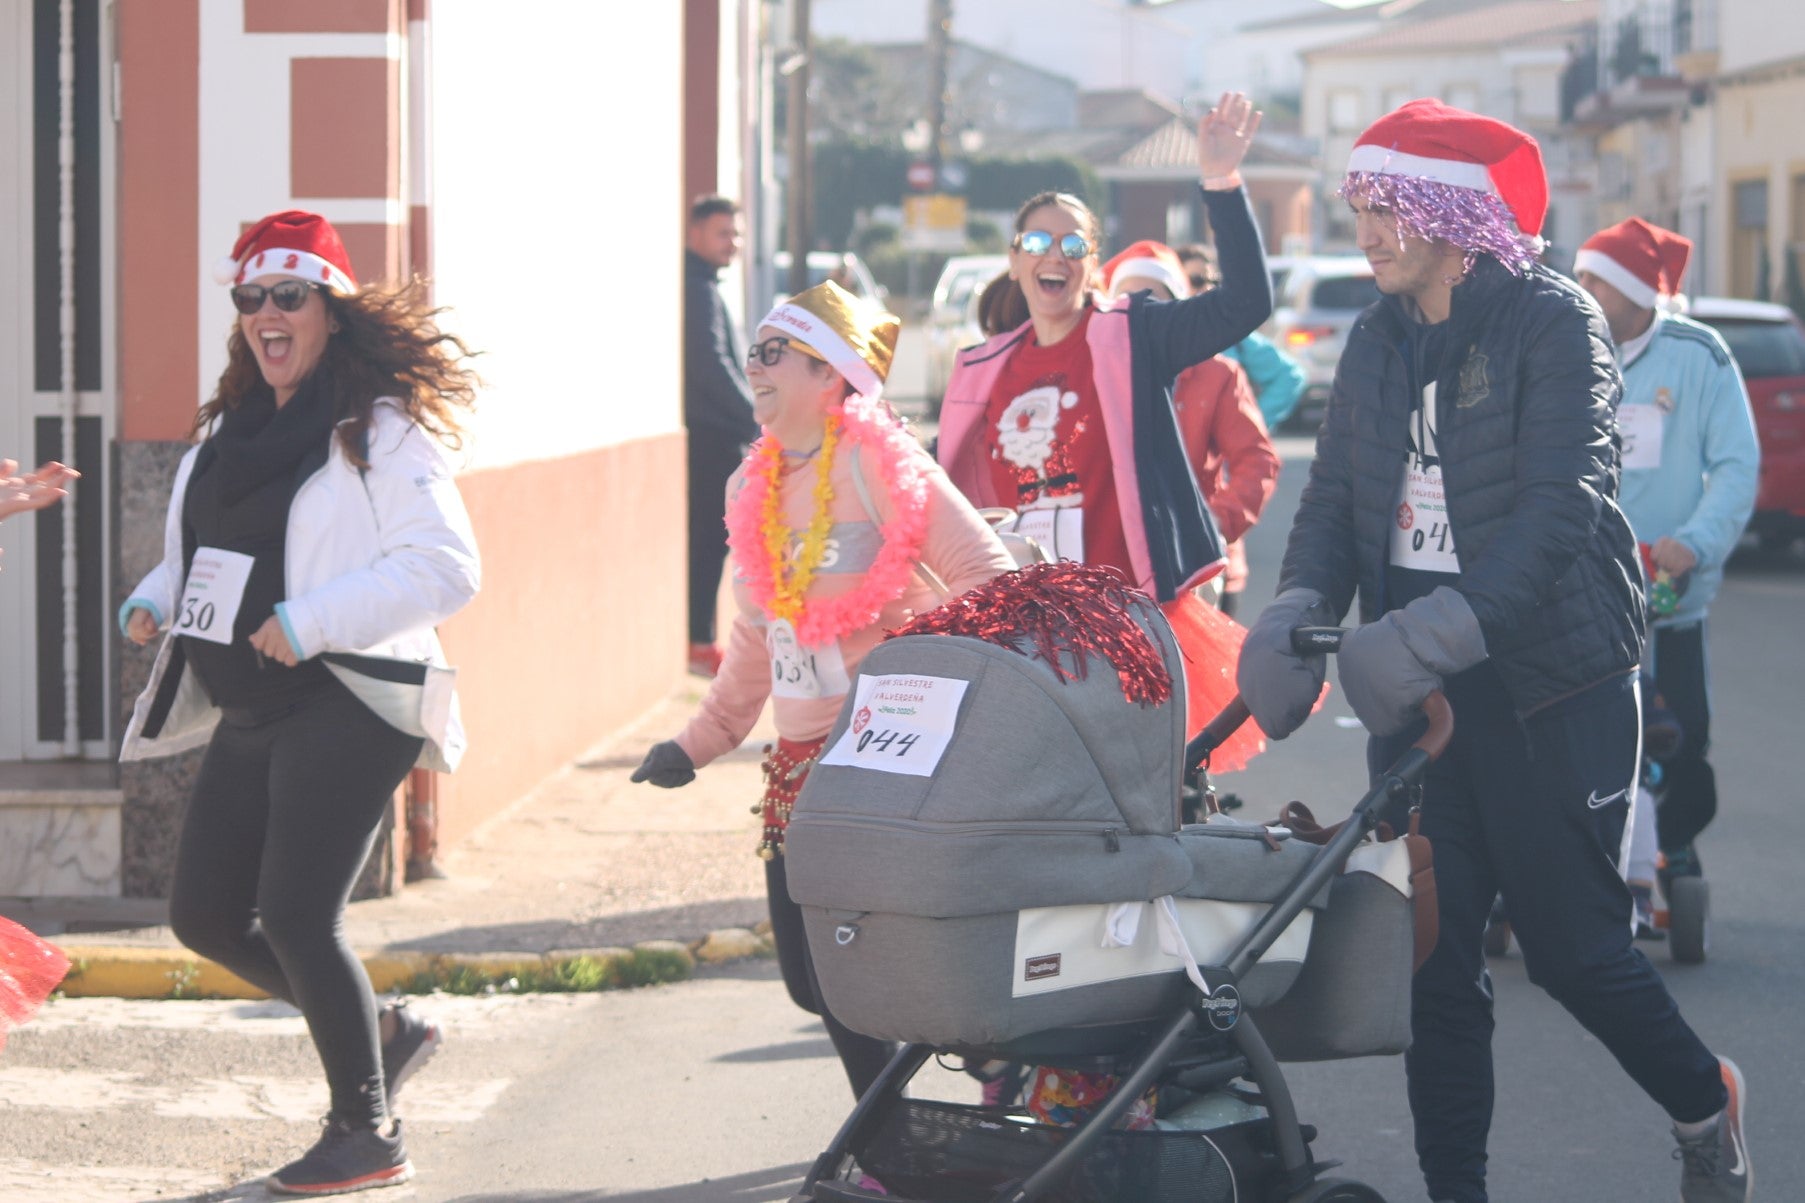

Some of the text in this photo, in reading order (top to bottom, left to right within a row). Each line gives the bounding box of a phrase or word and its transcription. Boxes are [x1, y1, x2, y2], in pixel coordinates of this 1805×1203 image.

[1412, 522, 1456, 554] 04
[892, 679, 934, 689] SILVESTRE
[856, 729, 921, 757] 044
